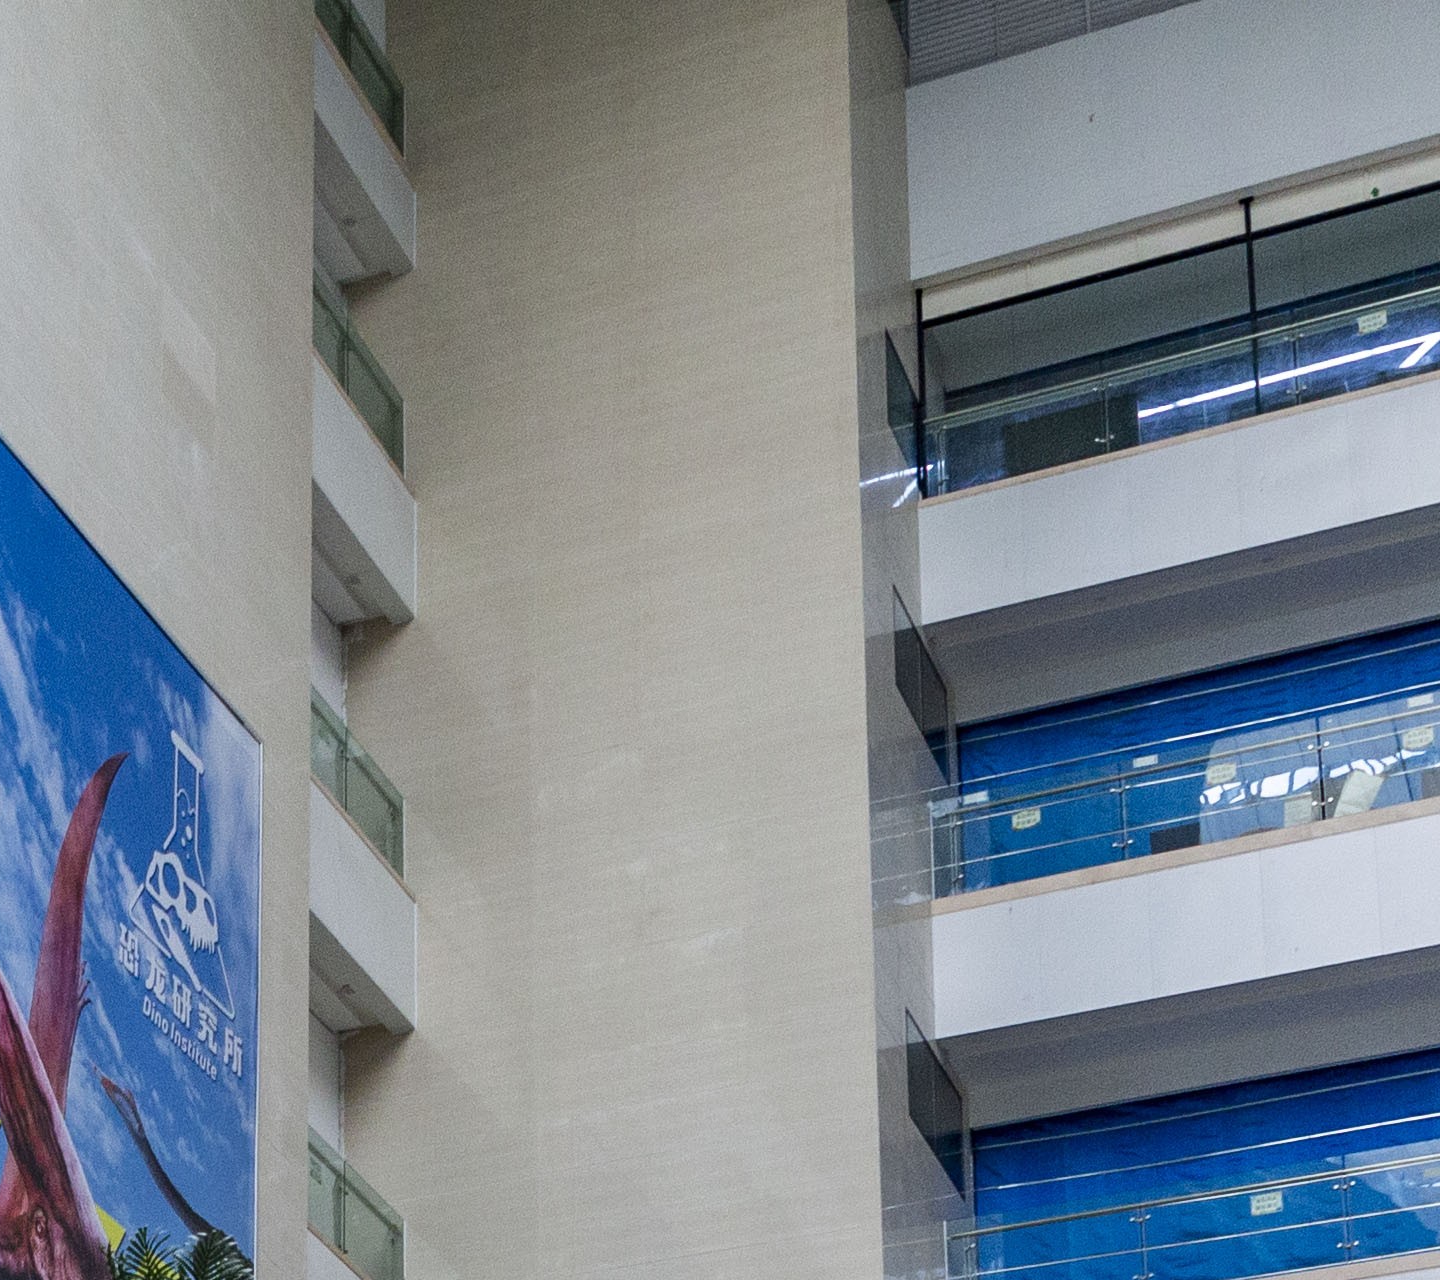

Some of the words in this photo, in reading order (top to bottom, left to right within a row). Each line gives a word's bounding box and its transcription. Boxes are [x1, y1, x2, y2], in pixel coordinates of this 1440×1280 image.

[119, 922, 242, 1078] 恐龙研究所
[142, 995, 169, 1035] Dino
[170, 1022, 217, 1081] Institute
